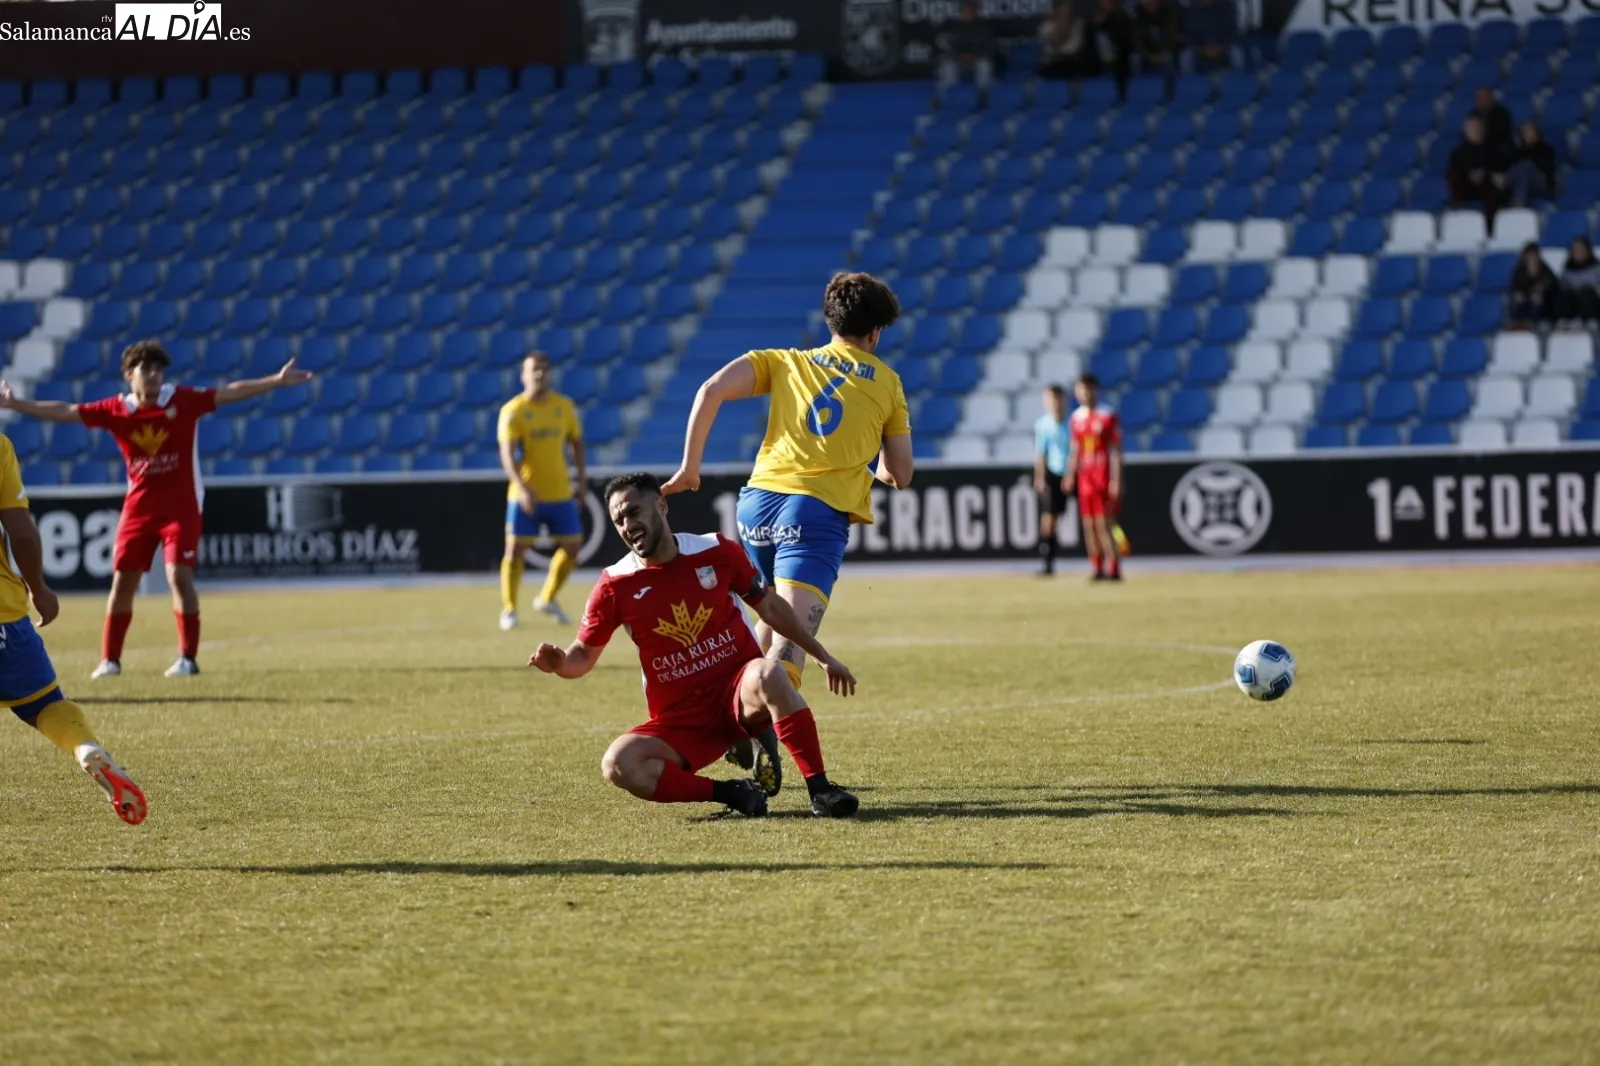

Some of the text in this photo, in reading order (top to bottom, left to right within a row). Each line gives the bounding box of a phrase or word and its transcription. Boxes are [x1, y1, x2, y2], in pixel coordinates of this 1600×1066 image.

[644, 15, 798, 50] Ayuntamiento
[902, 0, 1054, 26] Dipuación
[806, 376, 847, 437] 6
[847, 474, 1080, 550] ERACIÓ
[1432, 471, 1600, 541] FEDER
[32, 509, 121, 579] ea
[197, 524, 421, 565] HIERROS DÍAZ
[652, 628, 736, 670] CAJA RURAL
[657, 644, 738, 683] DE SALAMANCA
